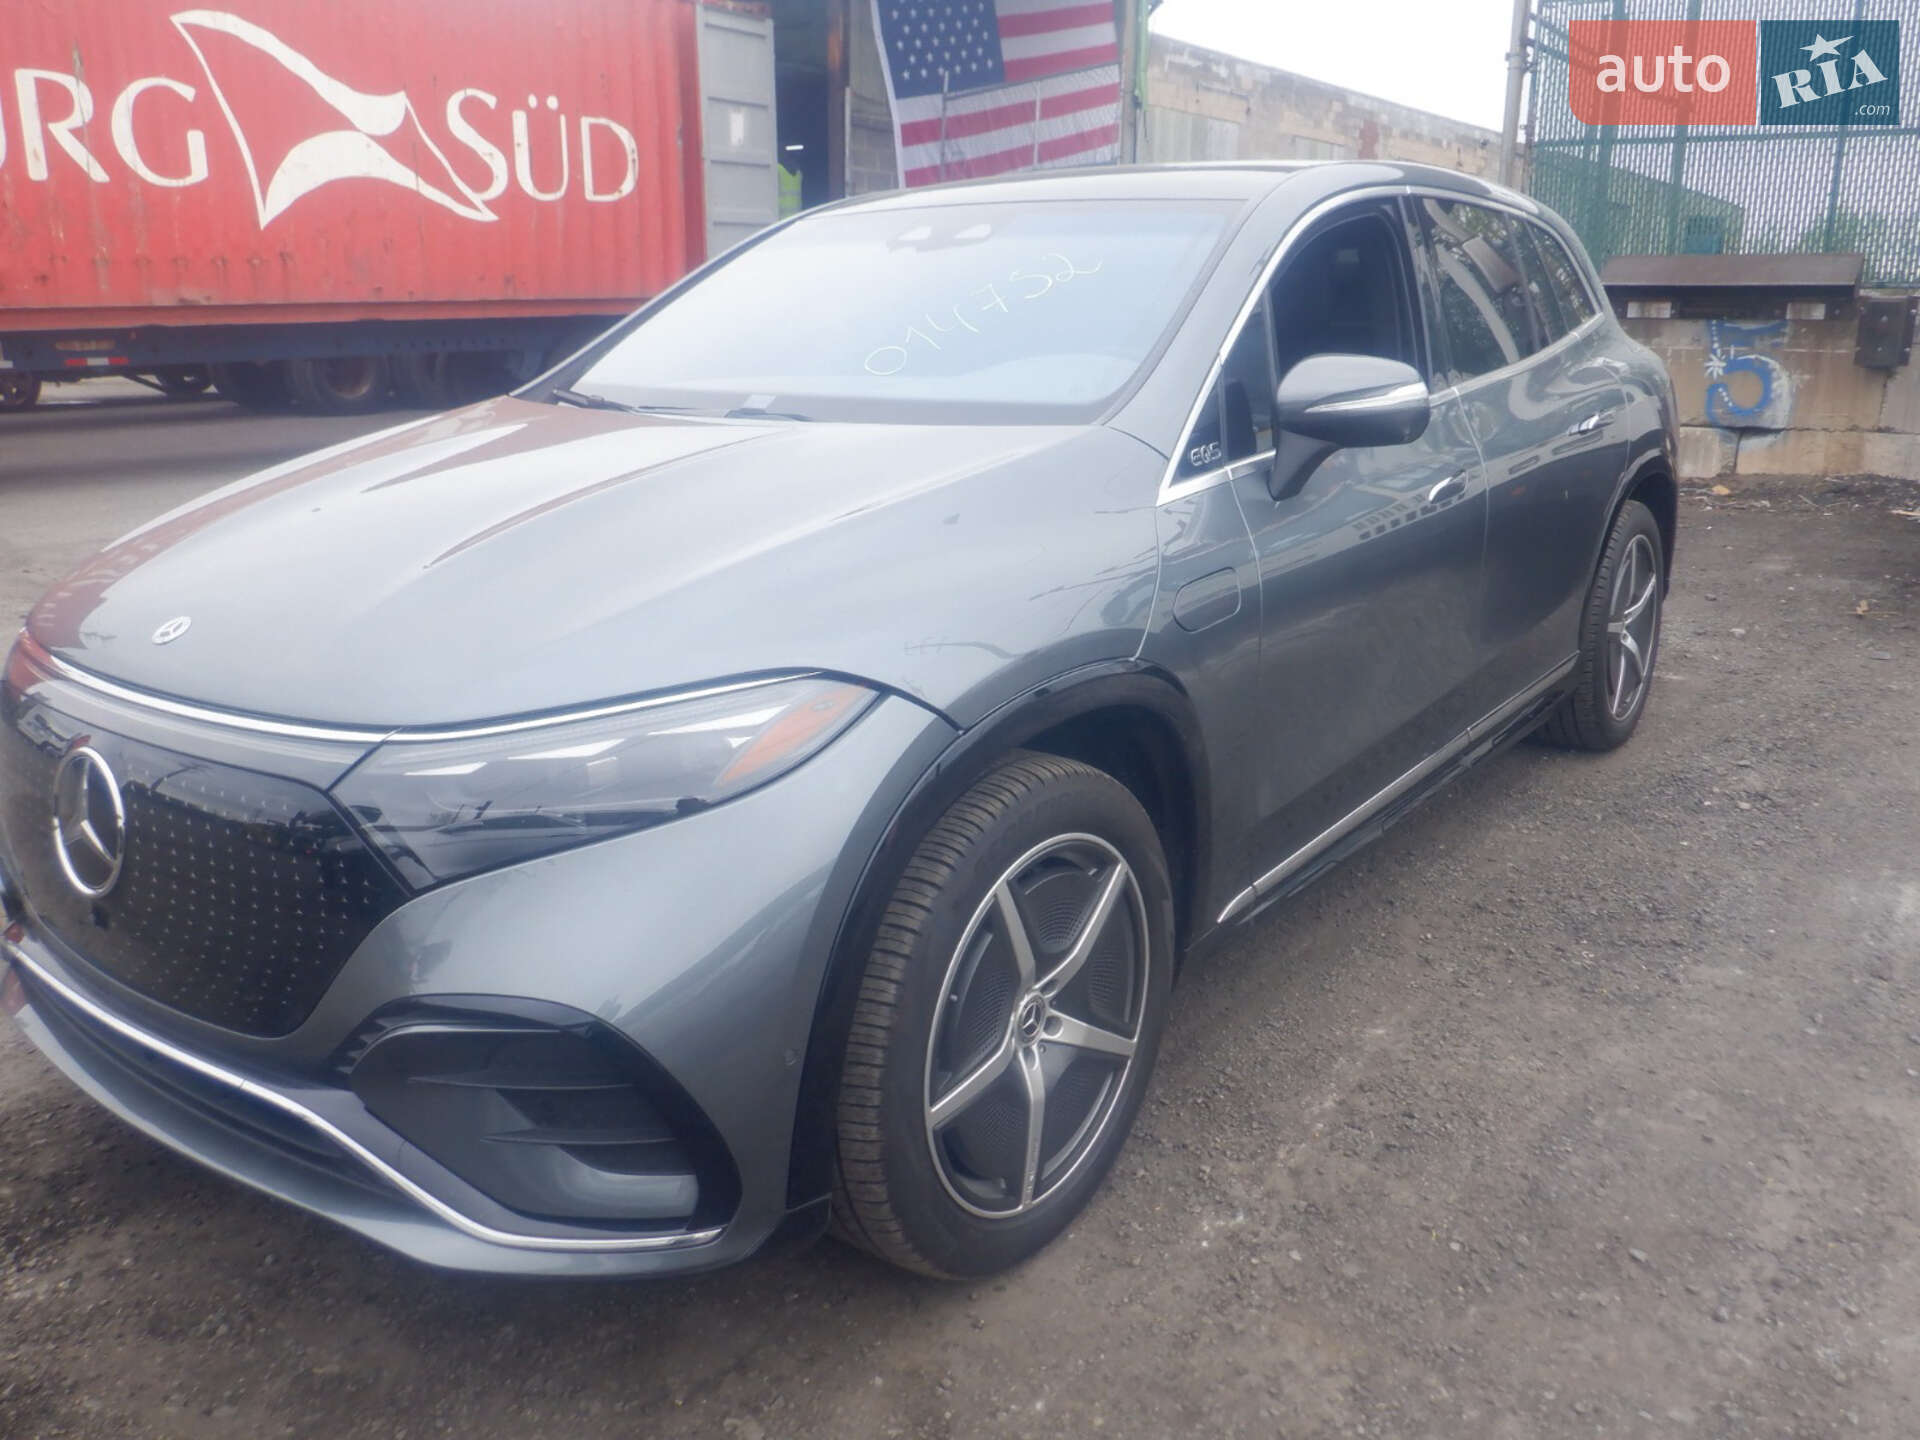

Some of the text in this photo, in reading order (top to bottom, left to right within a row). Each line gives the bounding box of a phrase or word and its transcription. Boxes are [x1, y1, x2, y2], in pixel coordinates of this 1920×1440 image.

[0, 68, 639, 203] RG SÜD
[1190, 440, 1222, 467] EQS
